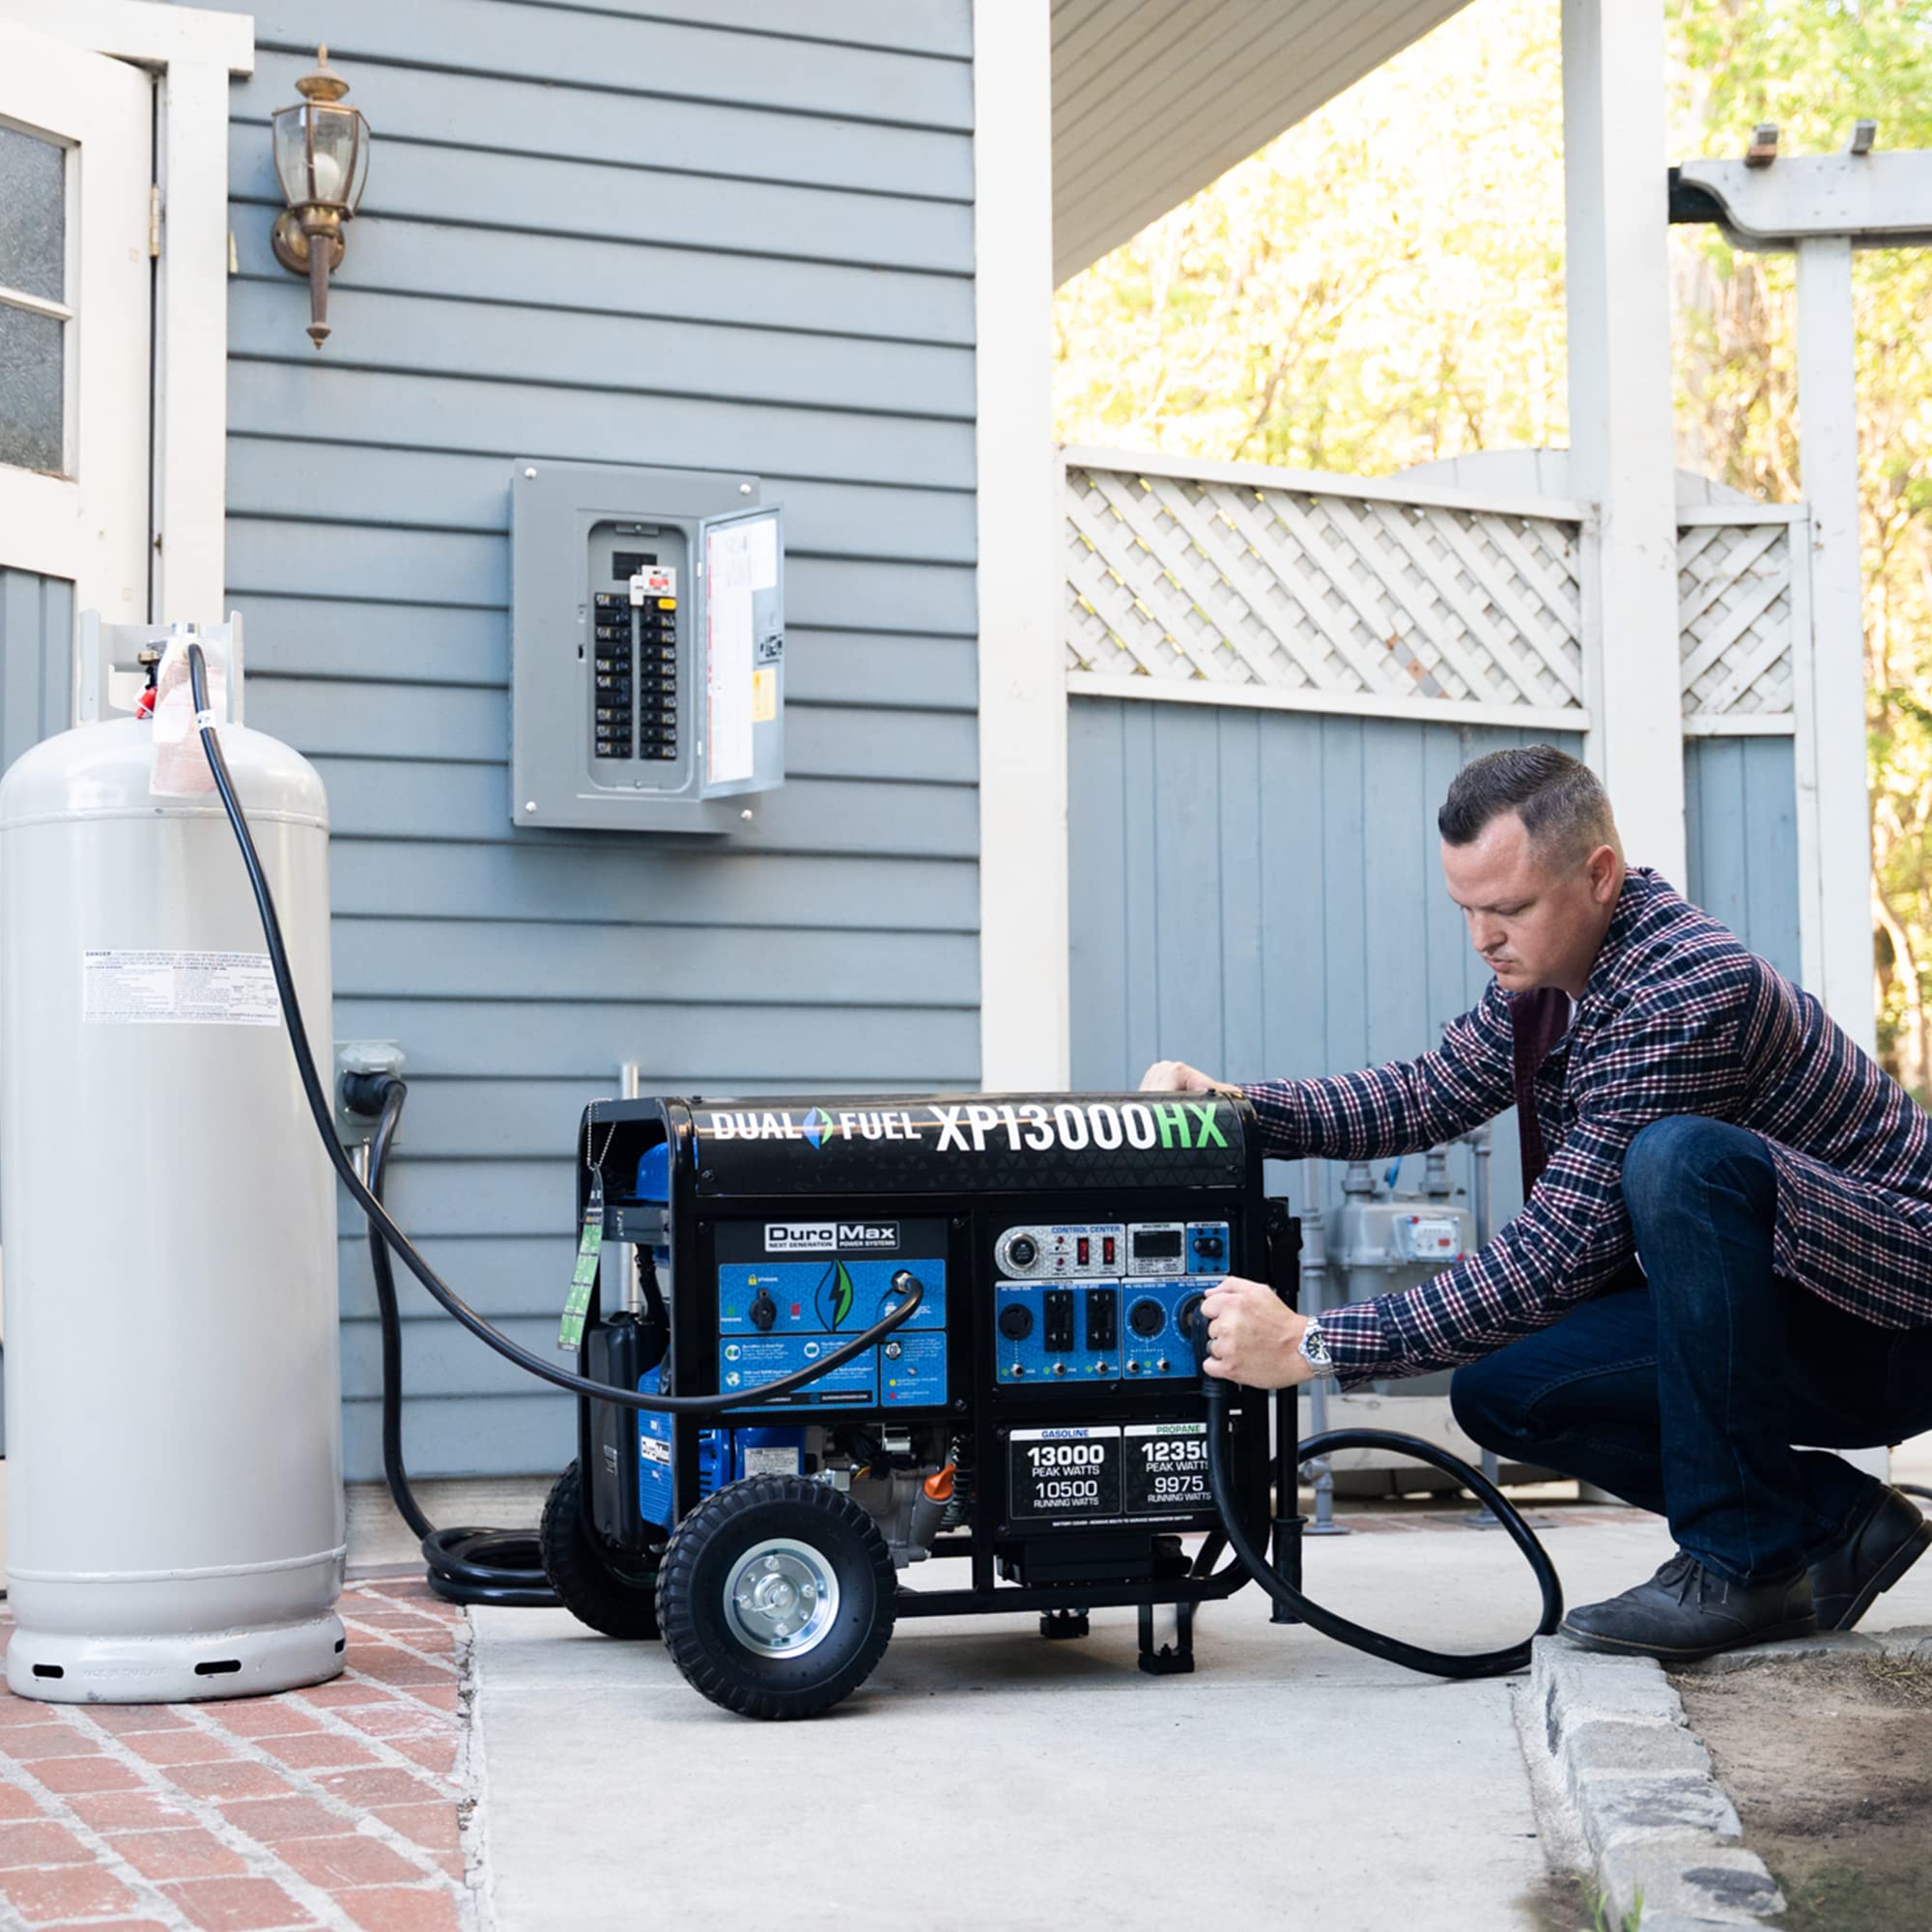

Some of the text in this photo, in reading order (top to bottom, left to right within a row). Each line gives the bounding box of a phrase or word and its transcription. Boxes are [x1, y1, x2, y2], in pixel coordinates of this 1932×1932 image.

[711, 1103, 1229, 1151] DUAL FUEL XP13000HX
[769, 1225, 895, 1241] Duro Max
[1089, 1225, 1121, 1234] CENTER
[1041, 1429, 1090, 1438] GASOLINE
[1155, 1424, 1201, 1434] PROPANE
[1027, 1444, 1104, 1466] 13000
[1032, 1464, 1100, 1478] PEAK WATTS
[1146, 1462, 1174, 1472] PEAK
[1036, 1480, 1098, 1499] 10500
[1154, 1475, 1204, 1493] 9975
[1034, 1496, 1099, 1508] RUNNING WATTS
[1148, 1492, 1212, 1502] RUNNING WATTS
